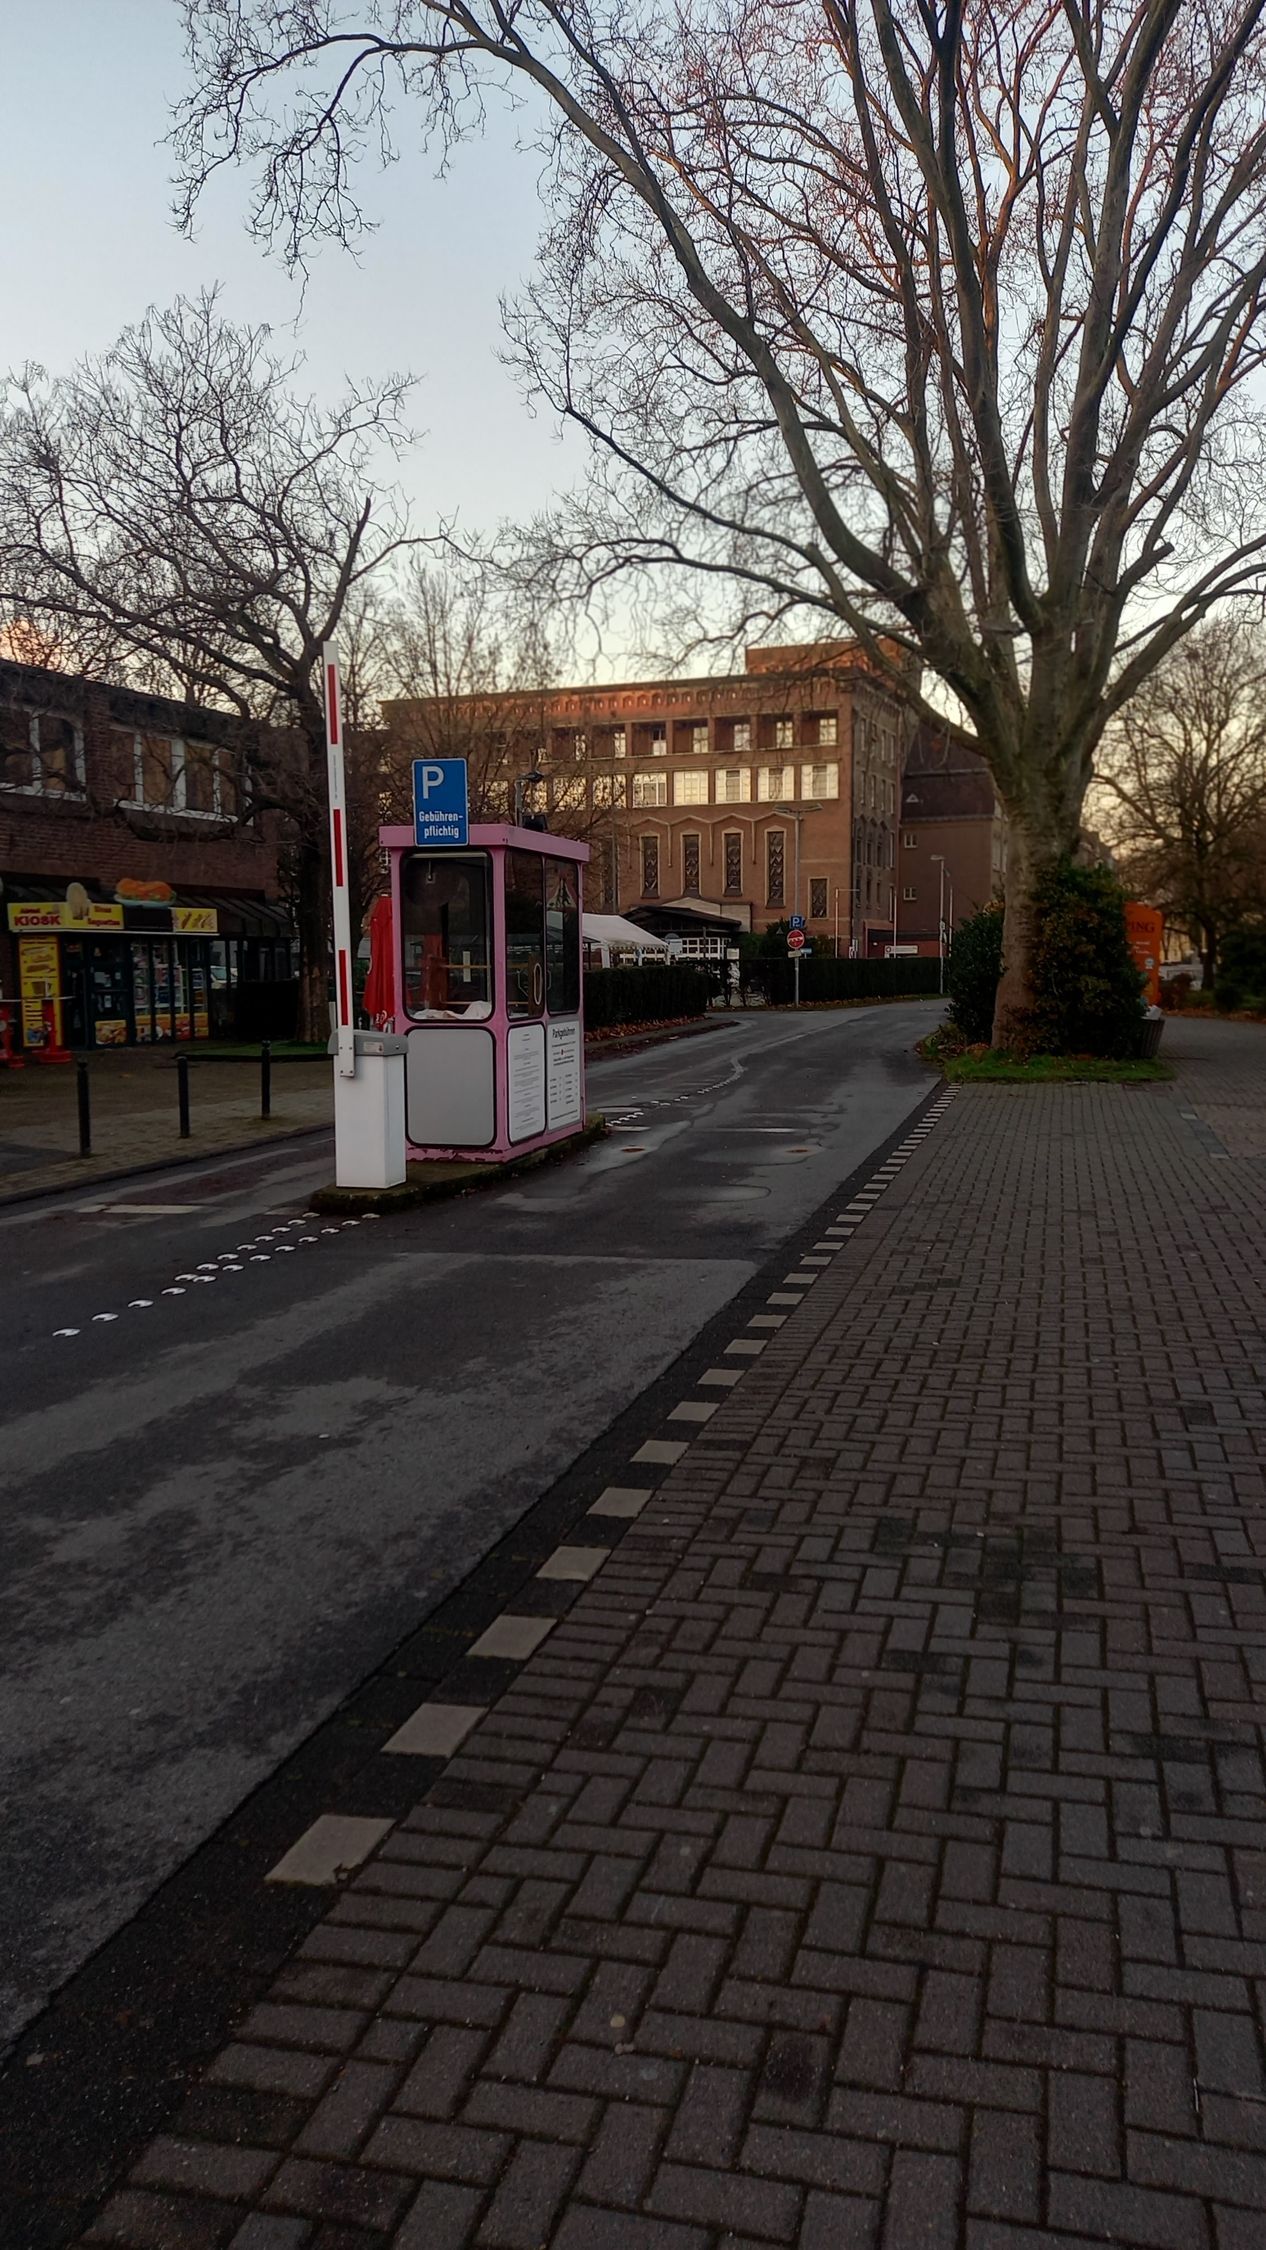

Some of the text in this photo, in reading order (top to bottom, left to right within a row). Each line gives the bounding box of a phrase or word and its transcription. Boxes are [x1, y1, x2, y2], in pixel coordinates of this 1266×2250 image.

[422, 766, 444, 799] P
[419, 811, 463, 822] Gebühren-
[424, 826, 459, 839] pflichtig
[14, 915, 62, 926] KIOSK
[792, 917, 800, 926] P
